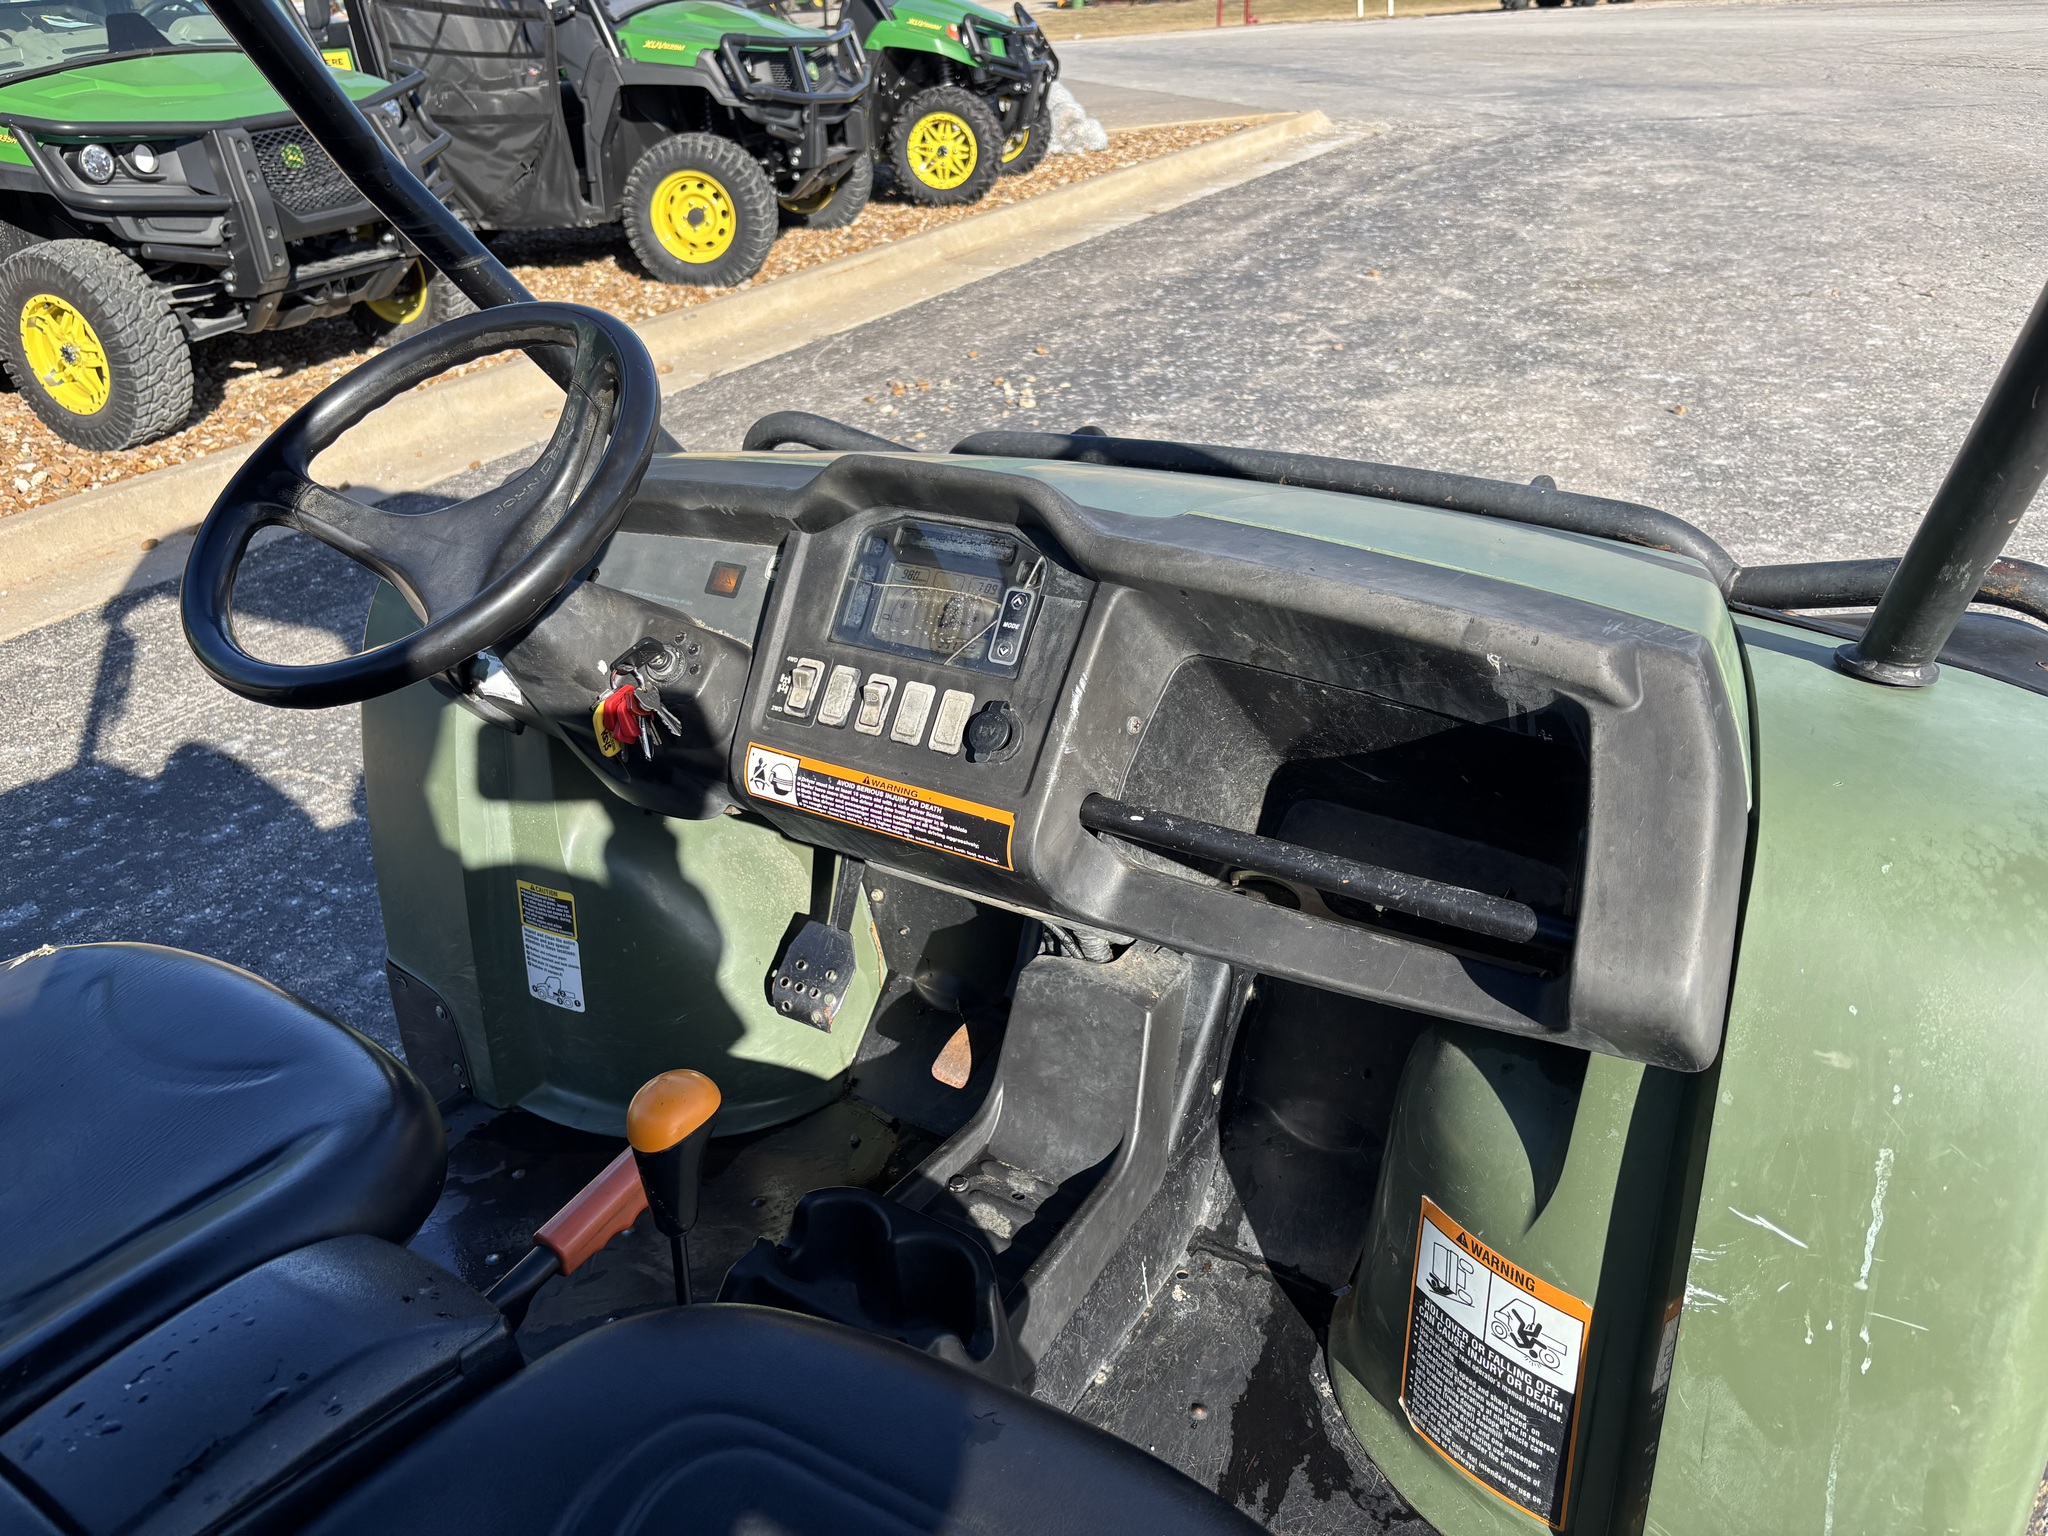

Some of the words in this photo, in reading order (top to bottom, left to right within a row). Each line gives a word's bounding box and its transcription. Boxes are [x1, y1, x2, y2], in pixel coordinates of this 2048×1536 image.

[493, 477, 541, 516] JOHN
[901, 569, 920, 582] 980
[1003, 621, 1020, 631] MODE
[771, 705, 783, 713] 2WD
[801, 776, 815, 785] Driver
[815, 780, 827, 788] must
[840, 787, 852, 795] least
[859, 793, 872, 802] years
[881, 798, 892, 806] with
[897, 802, 909, 811] valid
[909, 806, 925, 815] driver
[925, 810, 944, 820] license
[836, 778, 855, 789] AVOID
[856, 784, 883, 797] SERIOUS
[884, 791, 908, 804] INJURY
[909, 798, 919, 807] OR
[920, 801, 941, 813] DEATH
[871, 779, 918, 797] WARNING
[535, 885, 558, 897] CAUTION
[1470, 1238, 1535, 1293] WARNING
[1418, 1303, 1435, 1326] CAN
[1436, 1320, 1466, 1353] CAUSE
[1466, 1345, 1504, 1380] INJURY
[1506, 1372, 1522, 1391] OR
[1525, 1384, 1563, 1413] DEATH
[1419, 1325, 1428, 1340] Use
[1429, 1335, 1440, 1351] seat
[1420, 1318, 1434, 1337] Watch
[1434, 1331, 1448, 1349] video
[1448, 1343, 1458, 1357] and
[1458, 1351, 1471, 1367] read
[1471, 1361, 1500, 1390] operator's
[1501, 1382, 1525, 1403] manual
[1526, 1397, 1547, 1416] before
[1548, 1411, 1563, 1423] use.
[1424, 1297, 1468, 1343] ROLLOVER
[1471, 1337, 1485, 1356] OR
[1487, 1349, 1532, 1386] FALLING
[1535, 1378, 1559, 1400] OFF
[1415, 1364, 1426, 1381] gain
[1426, 1375, 1442, 1396] speed
[1442, 1389, 1475, 1422] (freewheel)
[1475, 1416, 1505, 1442] downhill.
[1416, 1357, 1425, 1371] Use
[1425, 1366, 1443, 1387] brakes
[1443, 1382, 1459, 1402] going
[1459, 1395, 1476, 1413] down
[1481, 1412, 1502, 1433] slope.
[1502, 1426, 1529, 1448] Vehicle
[1529, 1444, 1543, 1456] can
[1417, 1341, 1424, 1353] Be
[1424, 1348, 1442, 1369] careful
[1442, 1364, 1453, 1379] and
[1453, 1374, 1467, 1390] slow
[1468, 1385, 1484, 1403] down
[1485, 1397, 1503, 1415] when
[1503, 1410, 1529, 1432] loaded,
[1530, 1428, 1540, 1438] on
[1418, 1334, 1432, 1352] Avoid
[1432, 1347, 1458, 1374] excessive
[1458, 1369, 1476, 1390] speed
[1477, 1383, 1489, 1397] and
[1489, 1392, 1508, 1412] sharp
[1509, 1405, 1529, 1423] turns.
[1435, 1367, 1456, 1391] terrain,
[1456, 1384, 1484, 1413] operating
[1485, 1406, 1492, 1417] at
[1493, 1412, 1509, 1429] night
[1510, 1425, 1518, 1433] or
[1519, 1428, 1527, 1439] in
[1527, 1435, 1557, 1455] reverse.
[1410, 1410, 1425, 1431] public
[1425, 1425, 1441, 1444] roads
[1441, 1440, 1447, 1450] or
[1447, 1445, 1477, 1474] highways.
[1412, 1395, 1430, 1418] alcohol
[1430, 1414, 1436, 1423] or
[1436, 1418, 1453, 1439] drugs.
[1413, 1380, 1426, 1398] Keep
[1426, 1394, 1440, 1410] arms
[1440, 1404, 1450, 1419] and
[1451, 1414, 1463, 1431] legs
[1464, 1424, 1471, 1435] in
[1471, 1430, 1491, 1451] during
[1492, 1446, 1506, 1460] use.
[1413, 1387, 1427, 1407] Never
[1427, 1401, 1447, 1426] operate
[1448, 1419, 1469, 1442] vehicle
[1469, 1436, 1488, 1456] under
[1488, 1450, 1499, 1463] the
[1500, 1458, 1531, 1483] influence
[1532, 1477, 1540, 1487] of
[1414, 1373, 1421, 1385] No
[1421, 1381, 1434, 1397] more
[1435, 1392, 1447, 1408] than
[1448, 1405, 1458, 1417] one
[1459, 1413, 1477, 1431] driver
[1477, 1426, 1489, 1440] and
[1490, 1437, 1503, 1449] one
[1503, 1446, 1541, 1473] passenger.
[1411, 1403, 1420, 1416] For
[1419, 1411, 1440, 1435] off-road
[1440, 1431, 1451, 1444] use
[1451, 1439, 1466, 1457] only.
[1466, 1451, 1478, 1465] Not
[1478, 1460, 1506, 1485] intended
[1507, 1479, 1518, 1492] for
[1518, 1487, 1531, 1500] use
[1532, 1495, 1541, 1505] on
